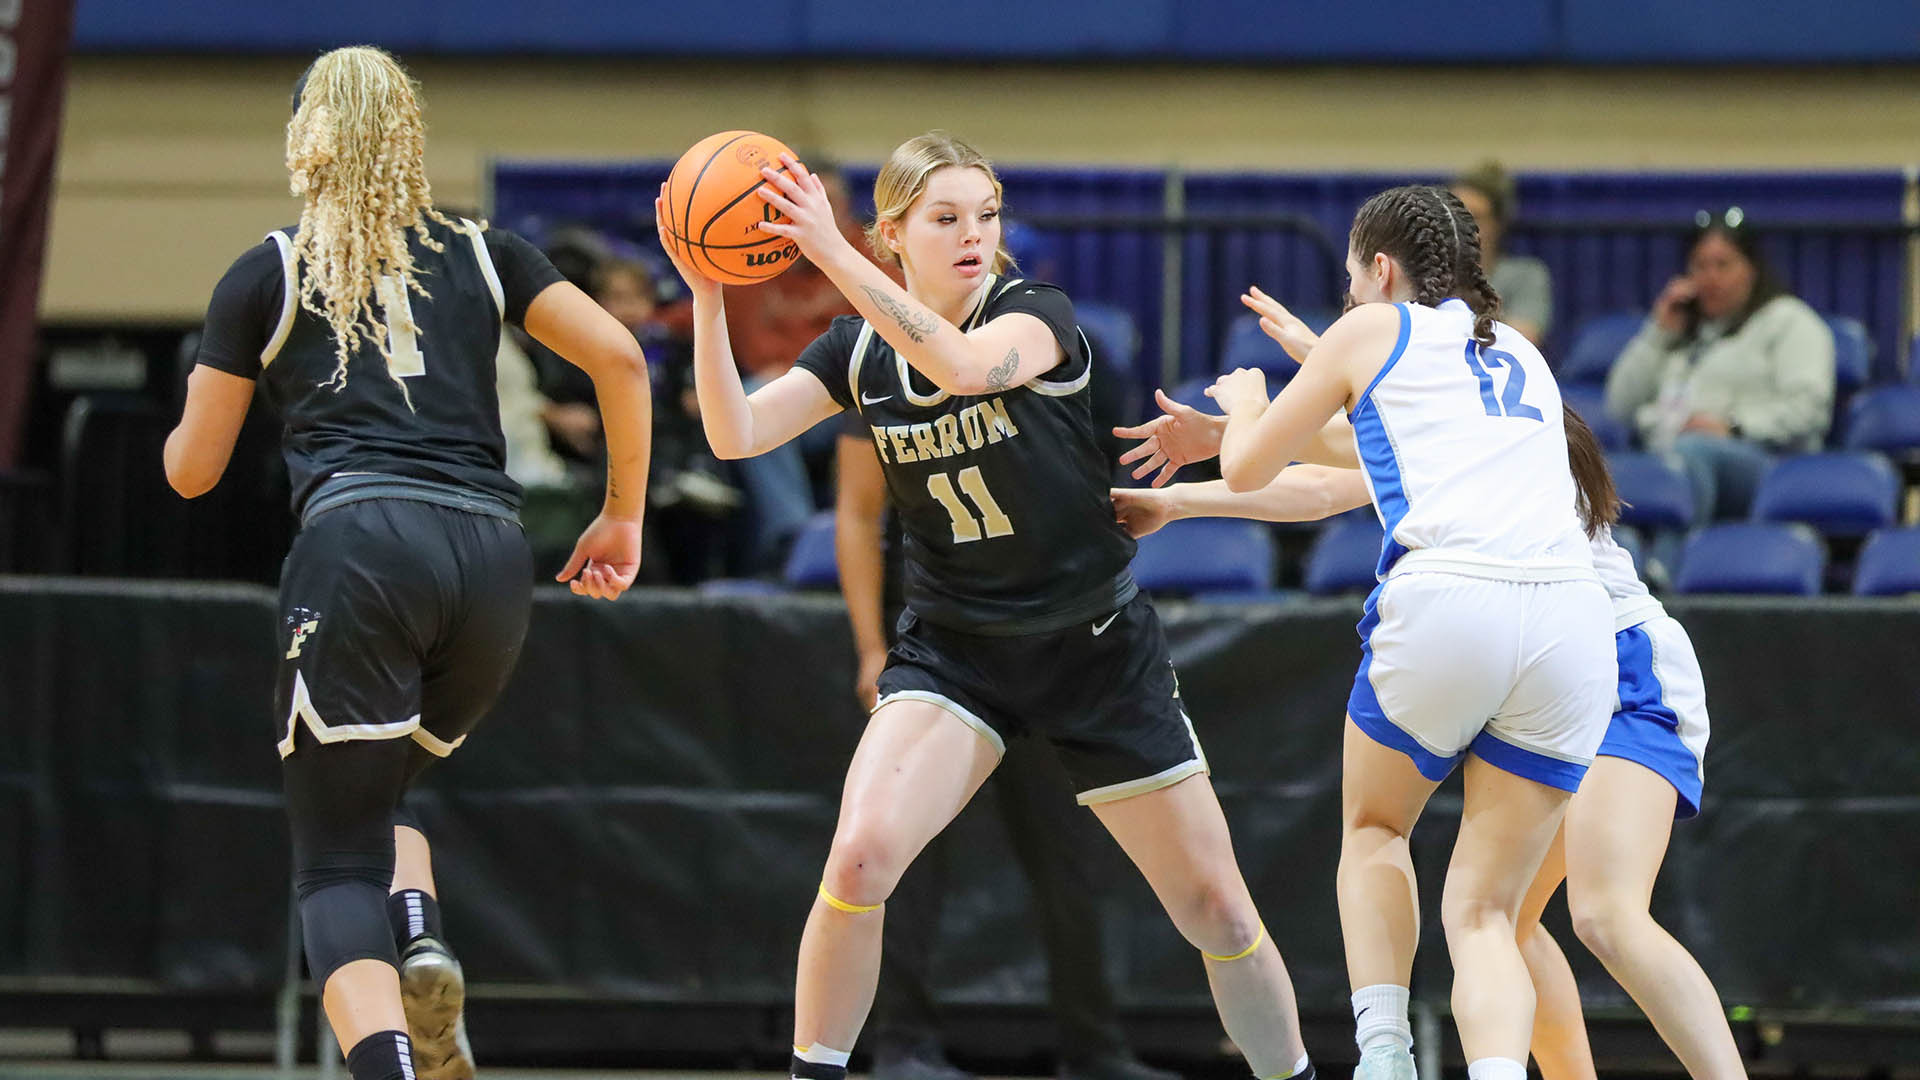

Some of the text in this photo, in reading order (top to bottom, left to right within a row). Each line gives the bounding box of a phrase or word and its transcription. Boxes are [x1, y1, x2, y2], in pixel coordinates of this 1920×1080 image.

[745, 242, 801, 267] lson
[376, 274, 427, 377] 1
[1464, 338, 1545, 423] 12
[870, 397, 1020, 464] FERRUM
[926, 465, 1015, 544] 11
